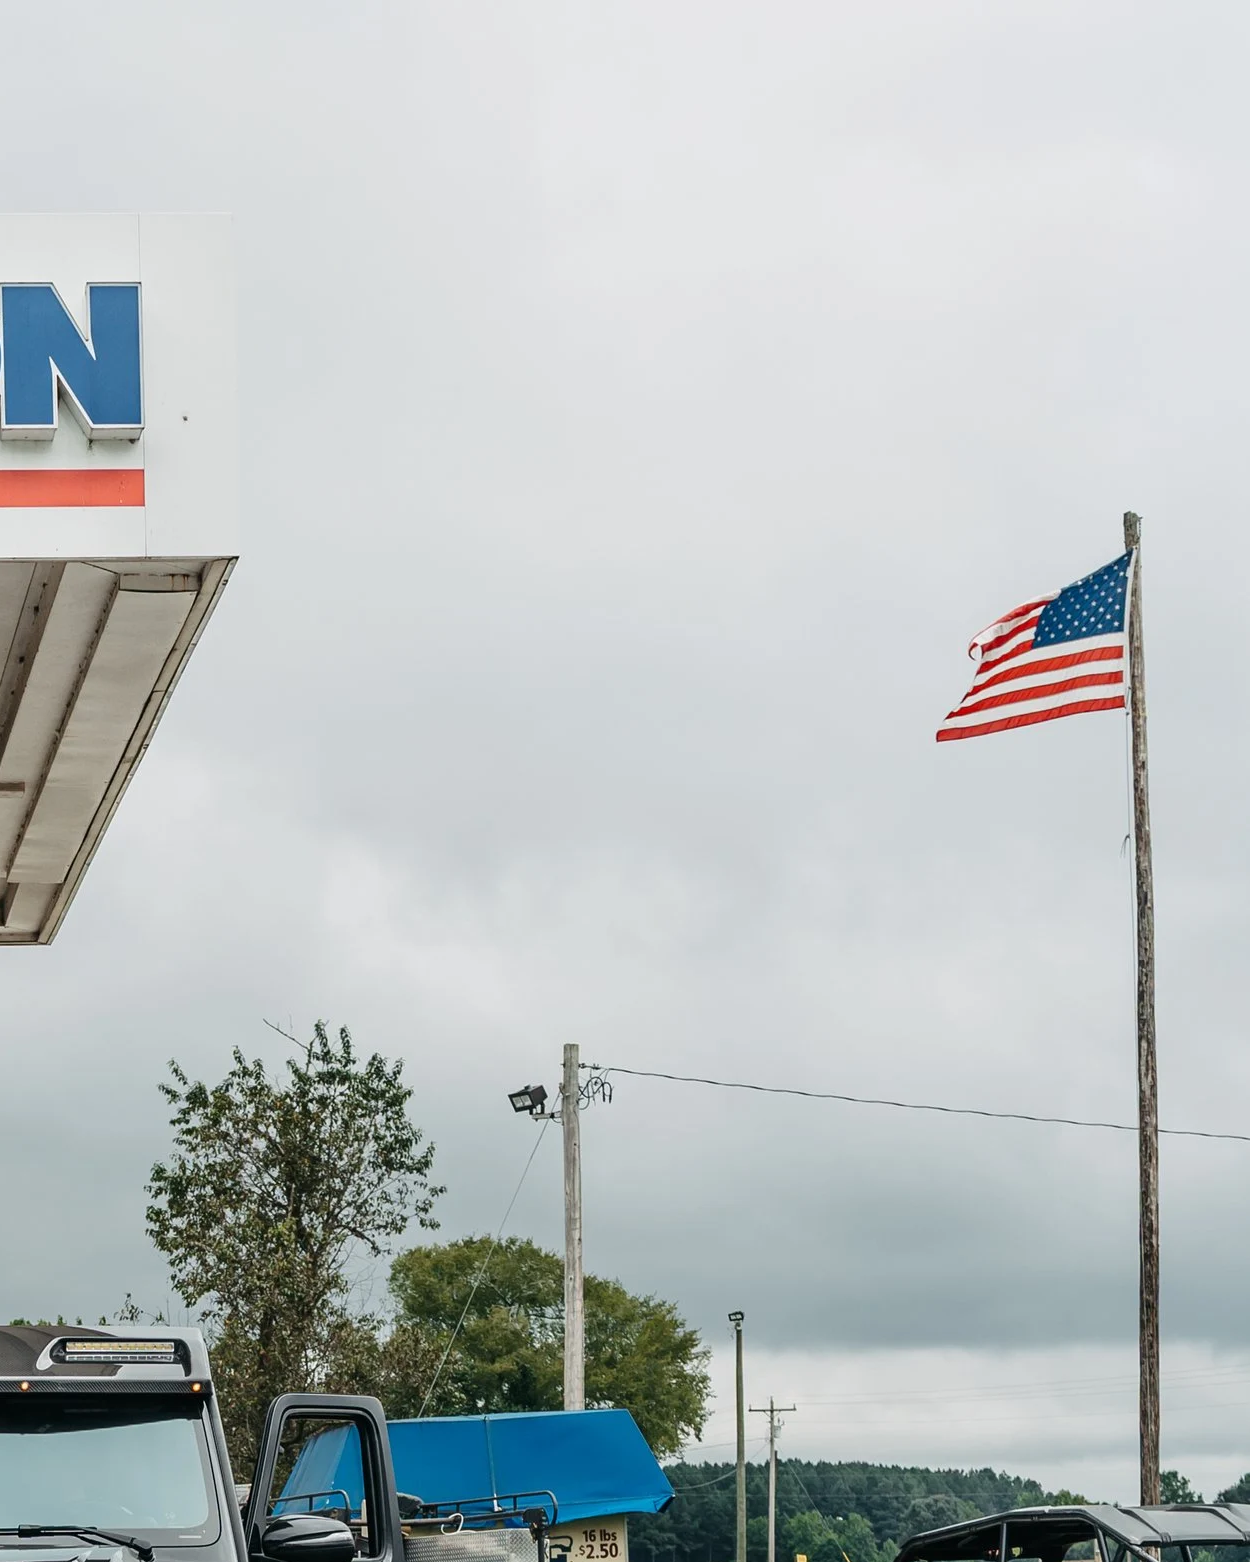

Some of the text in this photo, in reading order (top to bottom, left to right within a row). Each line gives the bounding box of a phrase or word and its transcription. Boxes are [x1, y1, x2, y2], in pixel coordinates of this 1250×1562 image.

[582, 1529, 617, 1542] 16 lbs
[579, 1543, 619, 1559] $2.50
